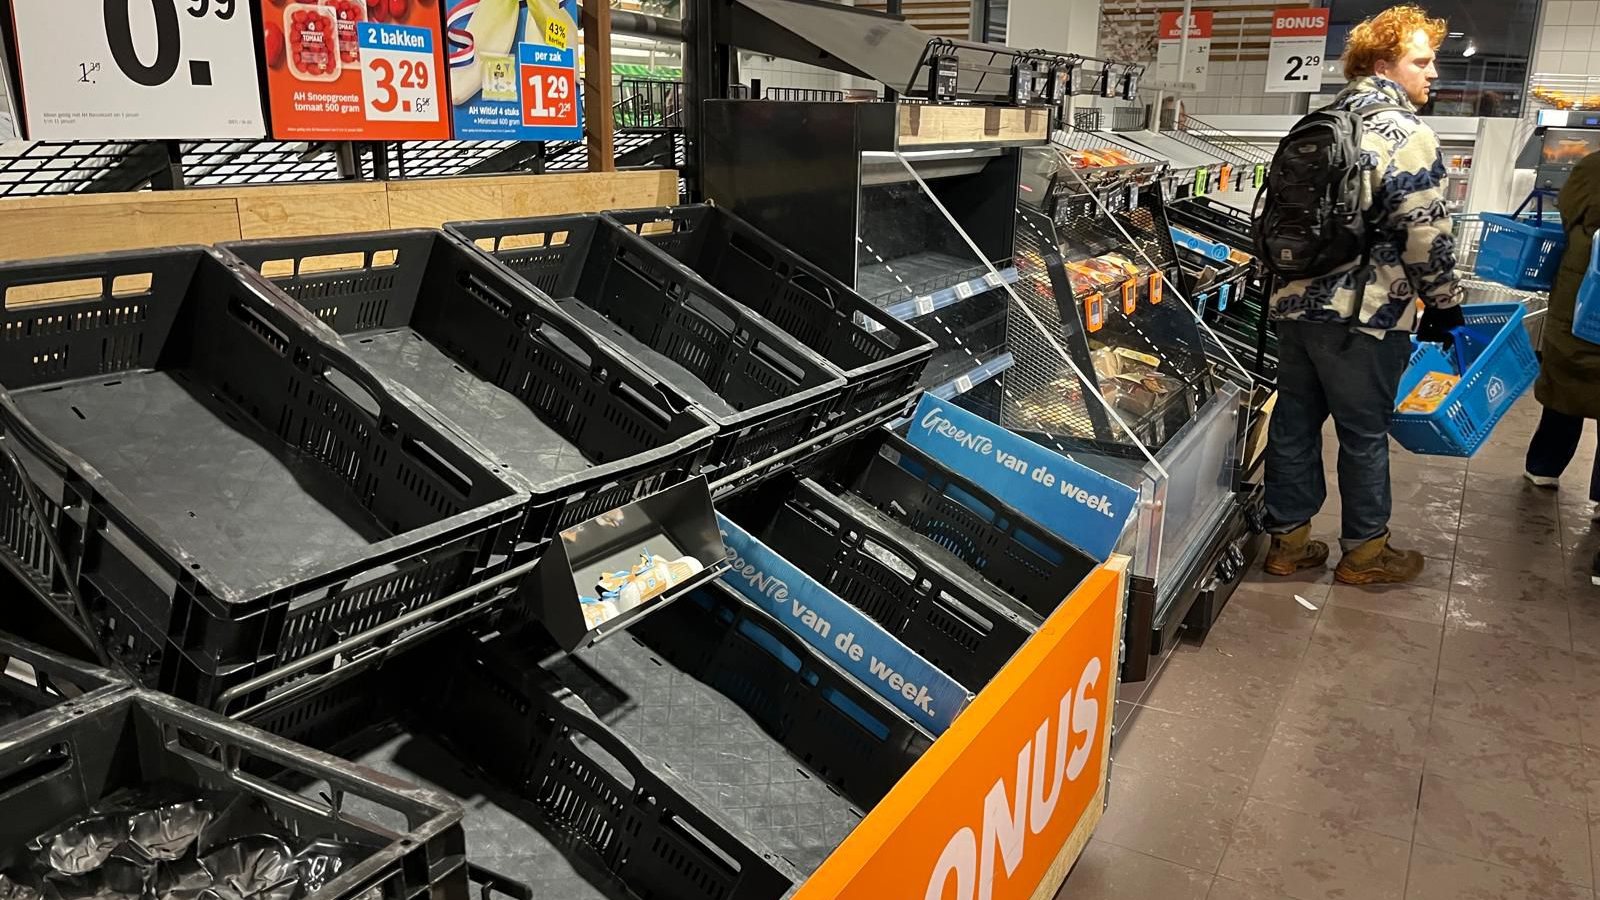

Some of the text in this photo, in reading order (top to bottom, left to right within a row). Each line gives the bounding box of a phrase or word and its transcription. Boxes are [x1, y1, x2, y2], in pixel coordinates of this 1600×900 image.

[549, 22, 565, 39] 43%
[1275, 16, 1325, 29] BONUS
[367, 28, 425, 48] 2 bakken
[534, 52, 562, 63] per zak
[1284, 55, 1320, 81] 2.29
[368, 57, 429, 112] 3.29
[293, 92, 359, 103] AH Snoepgroente
[528, 74, 569, 118] 1.29
[294, 103, 360, 113] tomaat 500 gram
[468, 106, 520, 116] AH Witlof 4 stuks
[995, 448, 1029, 476] van
[1031, 463, 1056, 488] de
[1059, 478, 1116, 519] week.
[791, 598, 831, 639] van
[834, 631, 864, 662] de
[869, 655, 936, 717] week.
